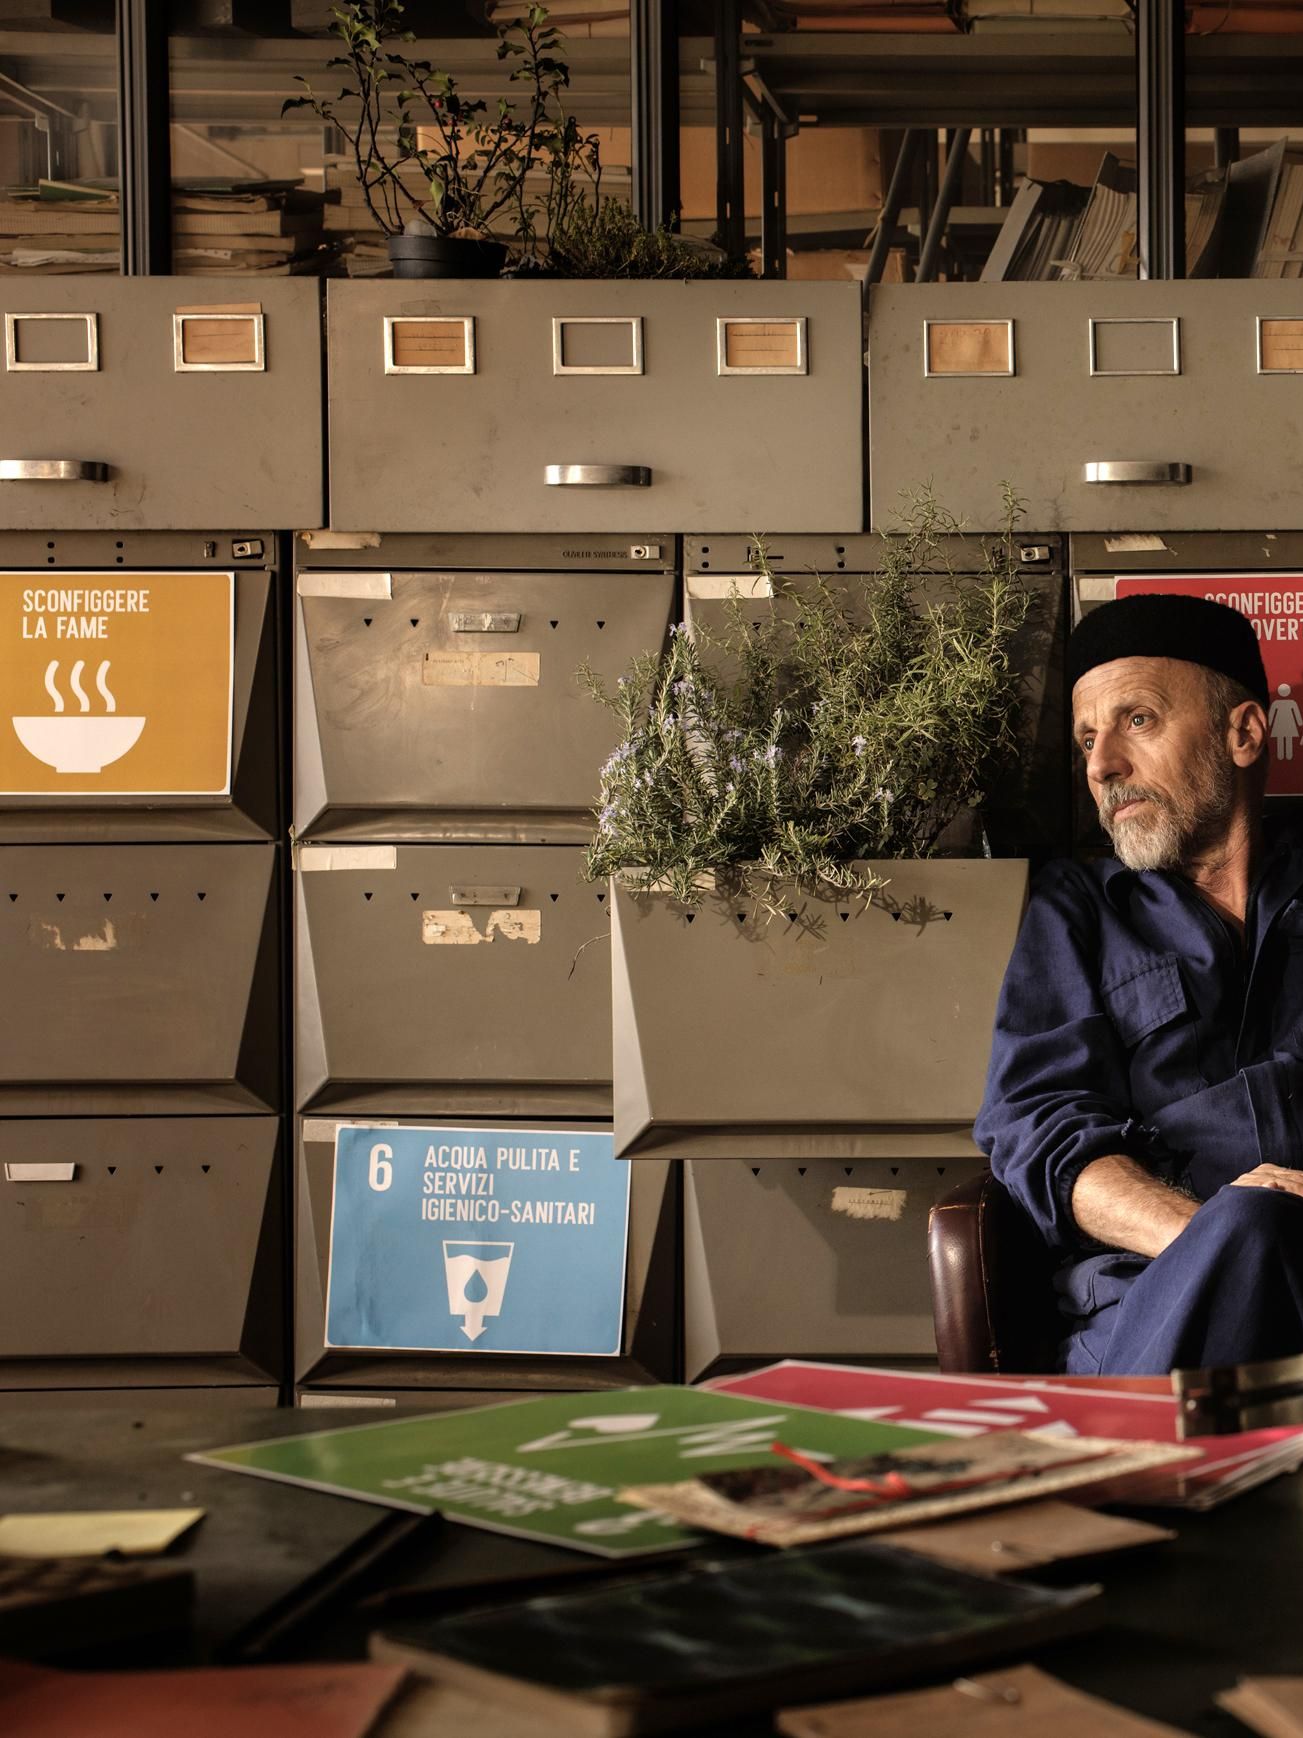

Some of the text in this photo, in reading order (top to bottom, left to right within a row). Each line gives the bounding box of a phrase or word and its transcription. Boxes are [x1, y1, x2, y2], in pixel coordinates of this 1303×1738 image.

[22, 589, 150, 612] SCONFIGGERE
[22, 616, 109, 639] LA FAME
[368, 1143, 394, 1192] 6
[424, 1145, 580, 1171] ACQUA PULITA E
[423, 1171, 494, 1196] SERVIZI
[421, 1198, 595, 1225] IGIENICO-SANITARI
